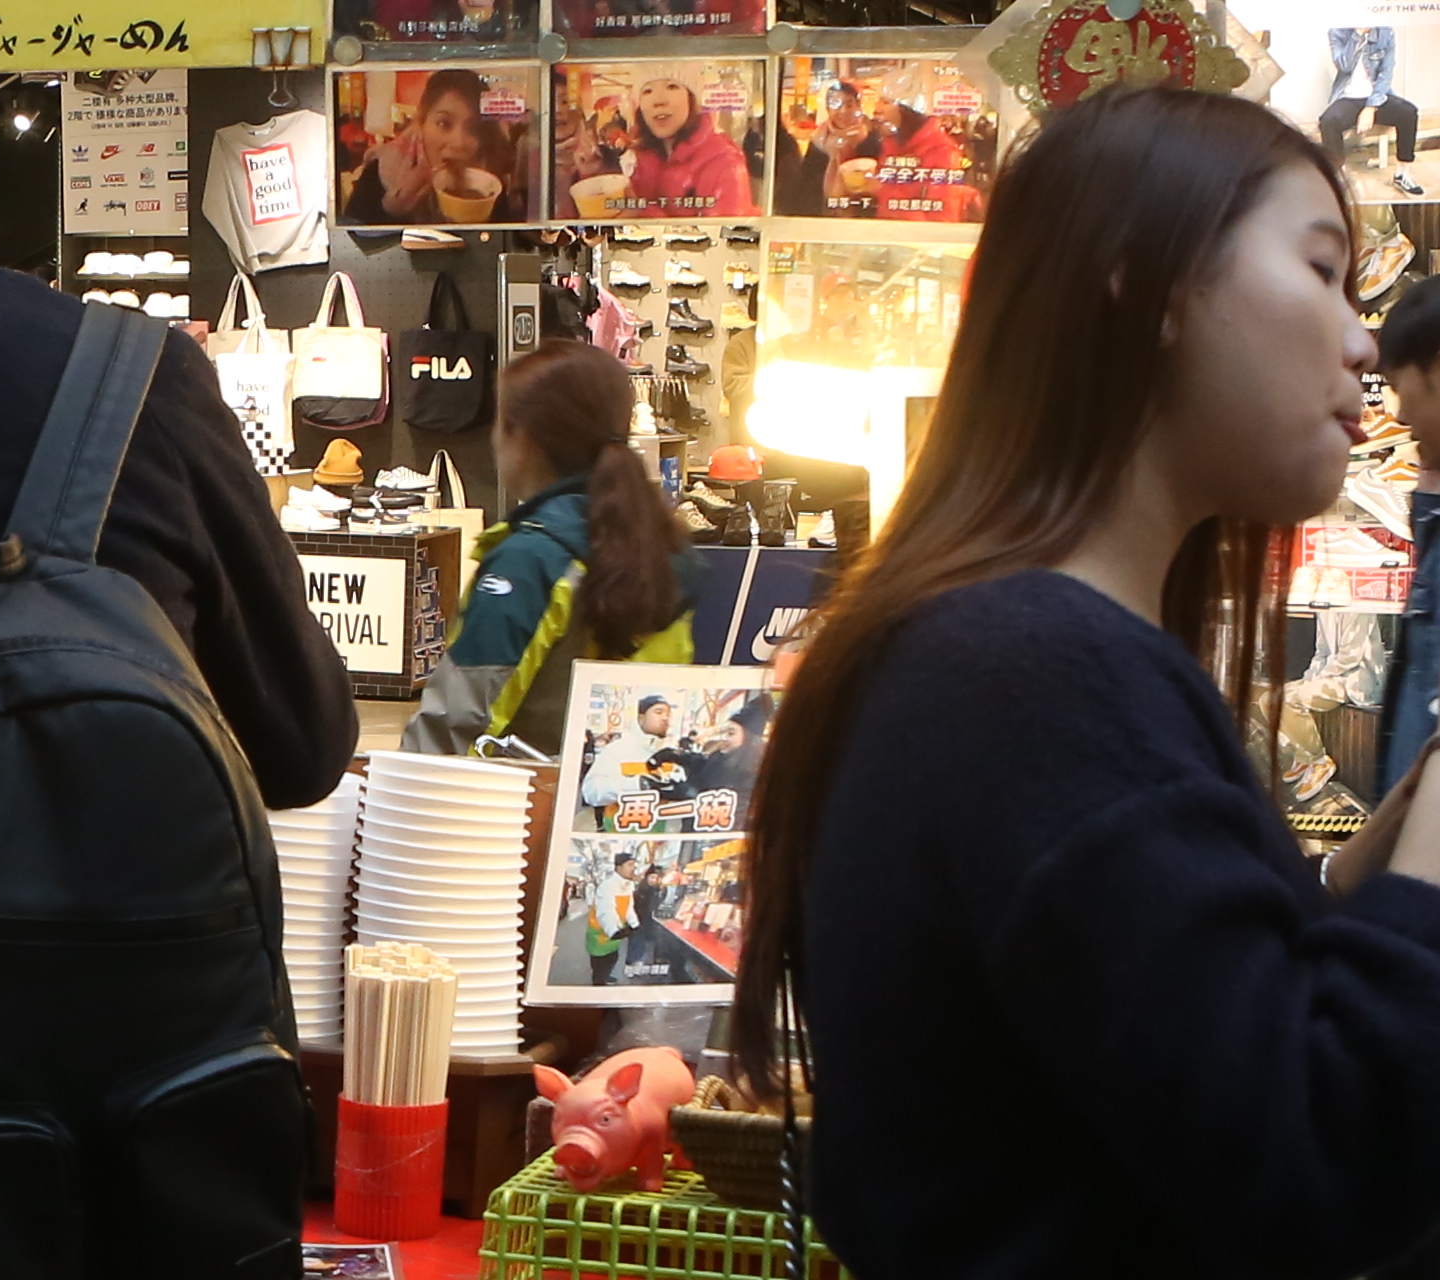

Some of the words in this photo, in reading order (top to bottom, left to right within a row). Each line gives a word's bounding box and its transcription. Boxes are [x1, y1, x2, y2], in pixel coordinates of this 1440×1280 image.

[248, 155, 288, 172] have
[265, 171, 275, 182] a
[255, 177, 293, 201] good
[259, 199, 295, 215] time
[411, 355, 473, 380] FILA
[309, 572, 367, 605] NEW
[616, 790, 738, 832] 再一碗
